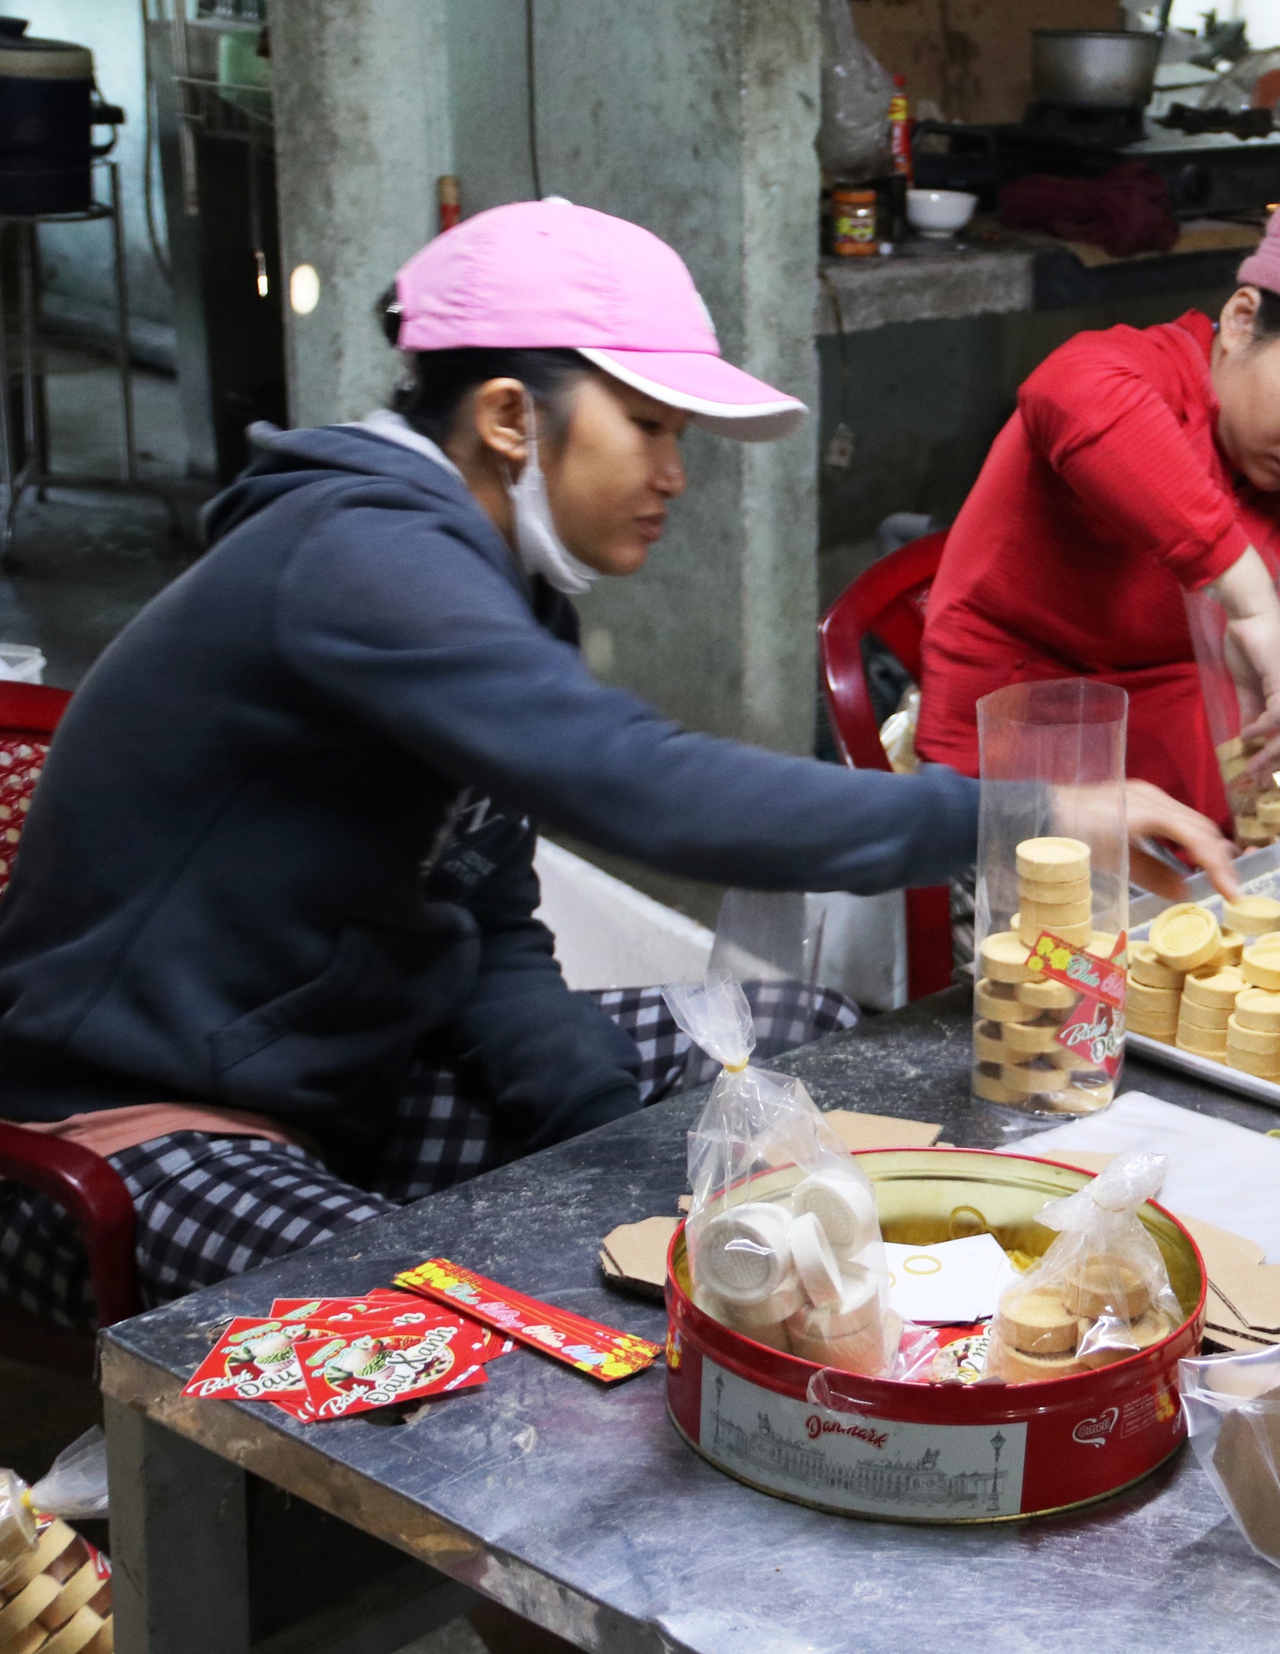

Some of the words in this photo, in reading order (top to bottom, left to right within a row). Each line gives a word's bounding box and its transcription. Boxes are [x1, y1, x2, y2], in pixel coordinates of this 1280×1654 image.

[186, 1369, 253, 1396] Bánh
[318, 1384, 369, 1416] Bánh
[387, 1327, 458, 1371] Xanh
[805, 1414, 888, 1448] Danmark
